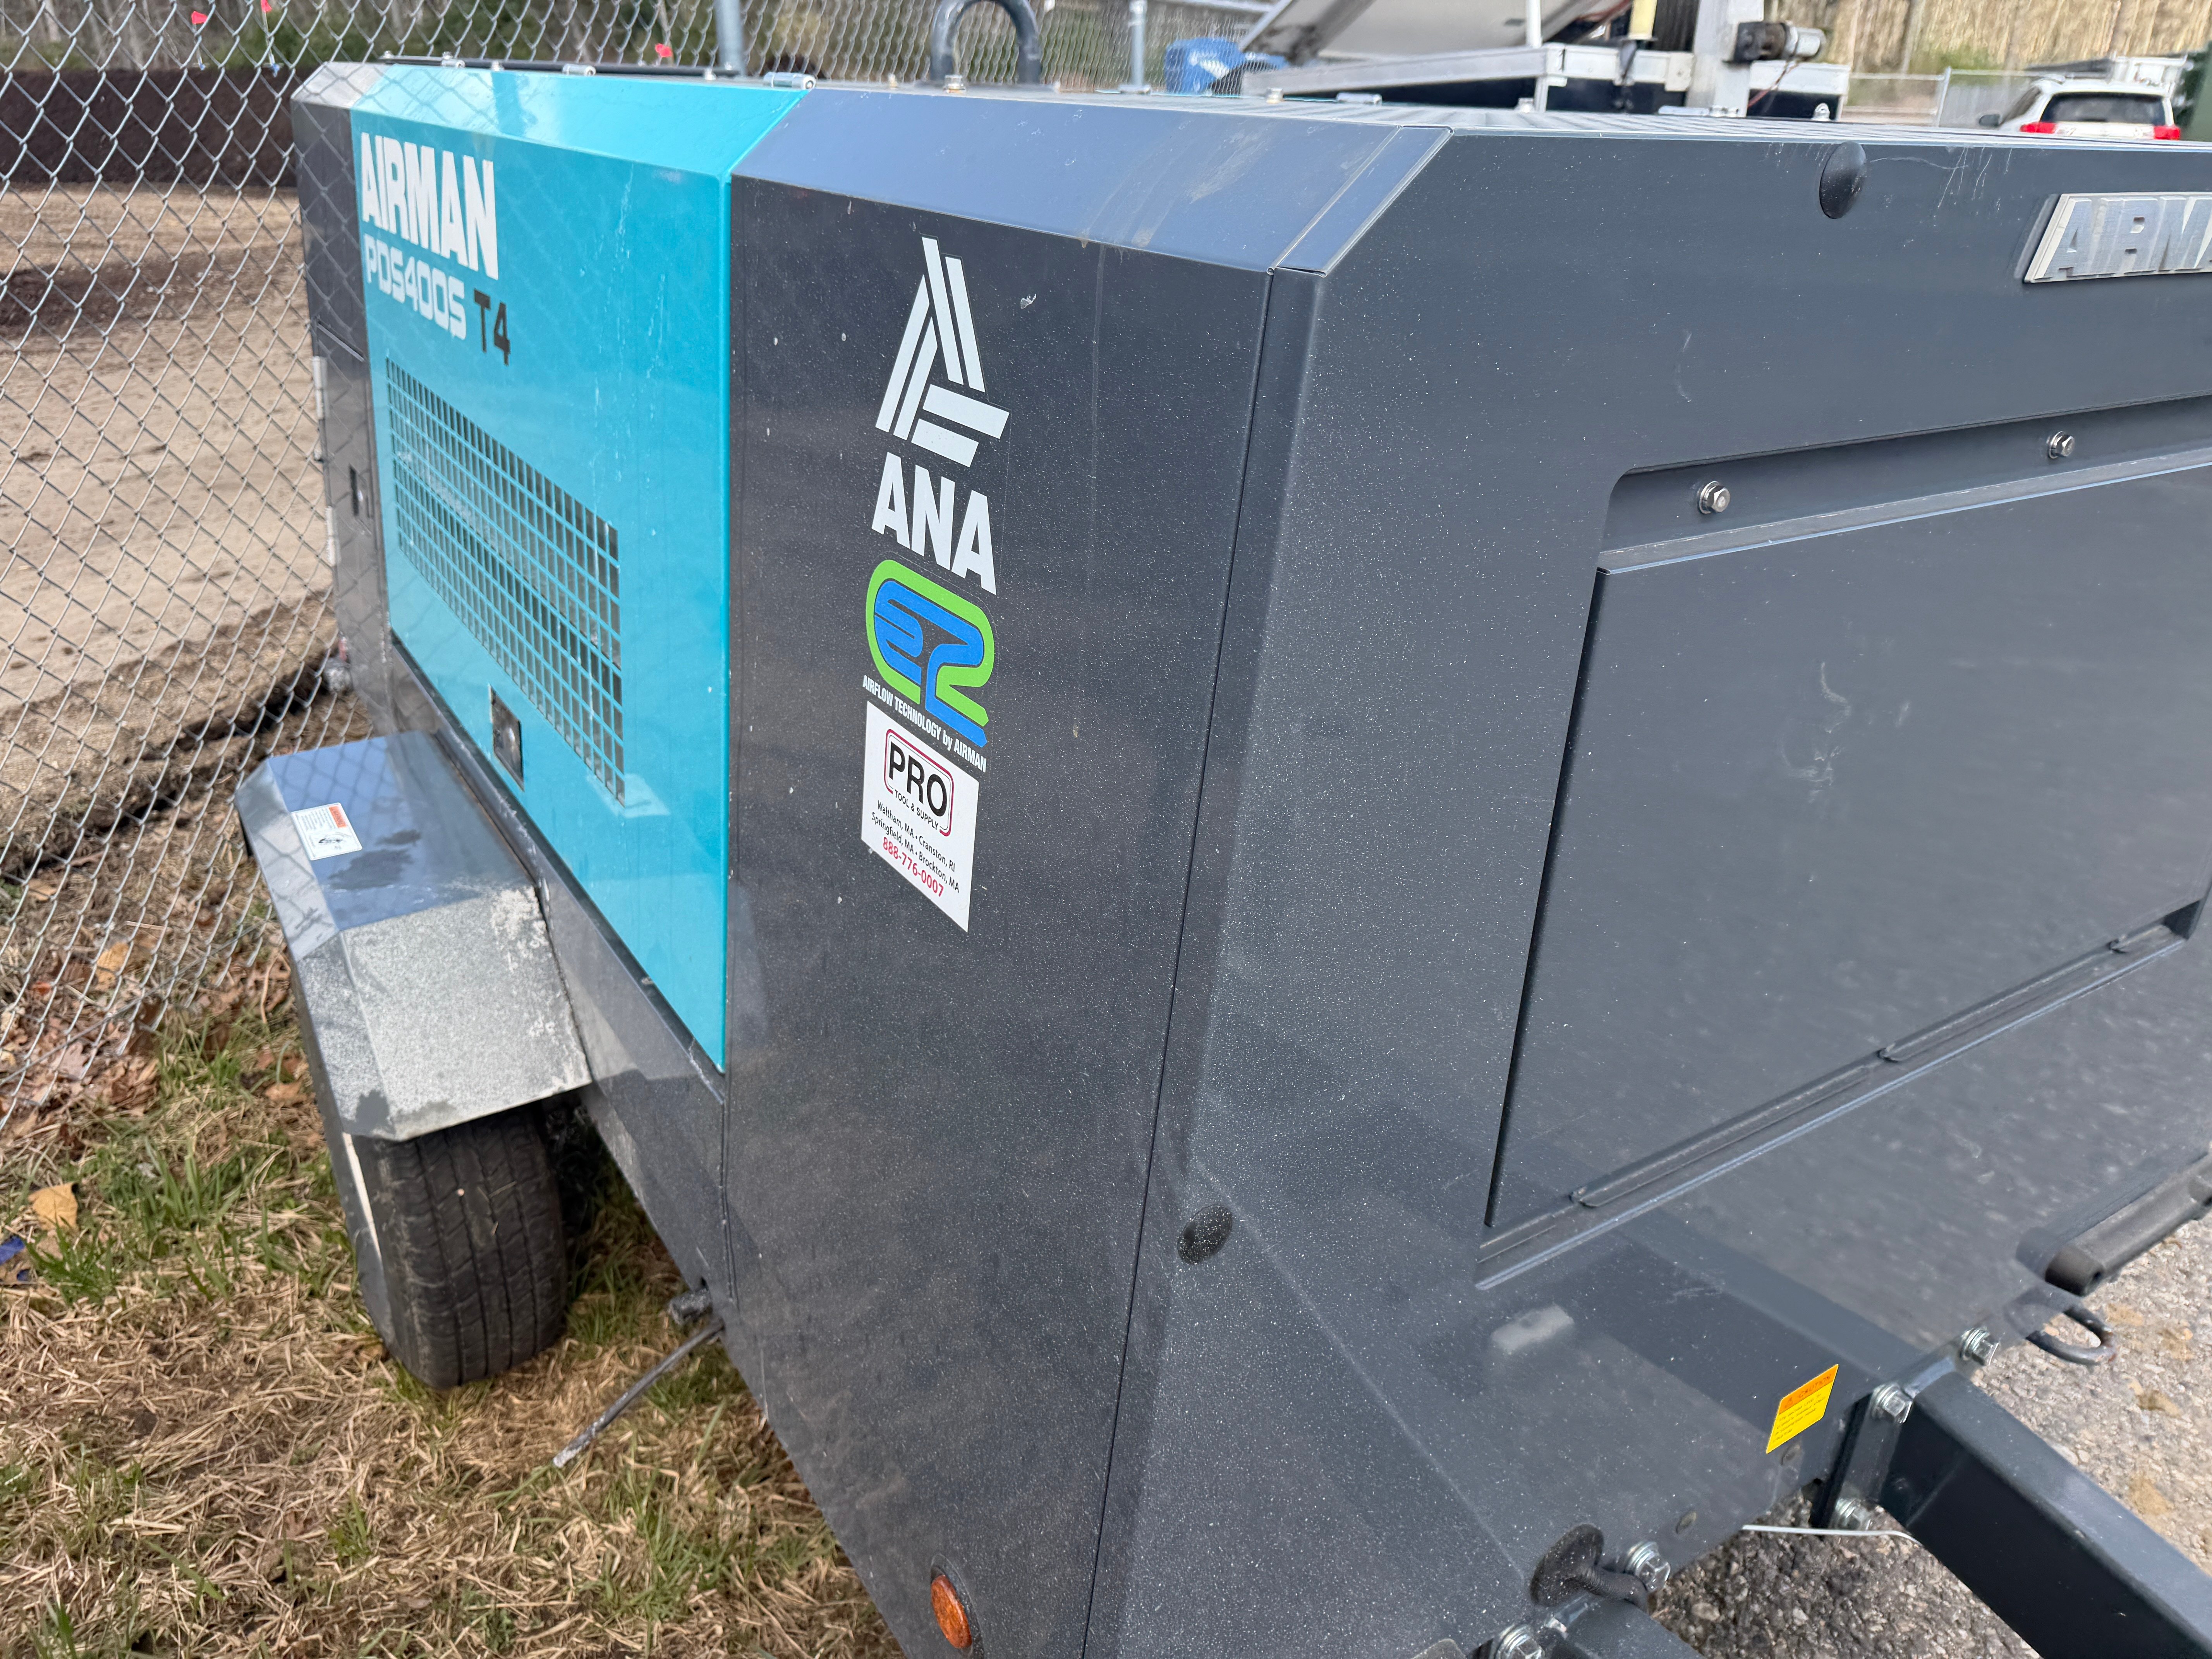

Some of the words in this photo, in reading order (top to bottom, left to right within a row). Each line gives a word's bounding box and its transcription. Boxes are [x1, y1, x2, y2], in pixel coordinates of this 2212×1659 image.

[361, 132, 499, 280] AIRMAN
[2035, 197, 2212, 277] AIRM
[363, 232, 467, 340] PDS400S
[474, 287, 511, 366] T4
[871, 452, 997, 595] ANA
[862, 675, 893, 707] AIRFLOW
[894, 696, 942, 740] TECHNOLOGY
[943, 730, 953, 751] by
[953, 738, 987, 773] AIRMAN
[889, 741, 947, 817] PRO
[895, 789, 909, 808] TOOL
[911, 803, 915, 812] &
[916, 807, 939, 830] SUPPLY
[872, 811, 903, 846] Springfield,
[904, 839, 914, 855] MA
[919, 851, 948, 884] Brockton,
[949, 876, 959, 893] MA
[878, 800, 903, 830] Waltham,
[904, 823, 914, 839] MA
[919, 835, 948, 867] Cranston,
[949, 859, 955, 872] RI
[883, 836, 944, 897] 888-776-0007
